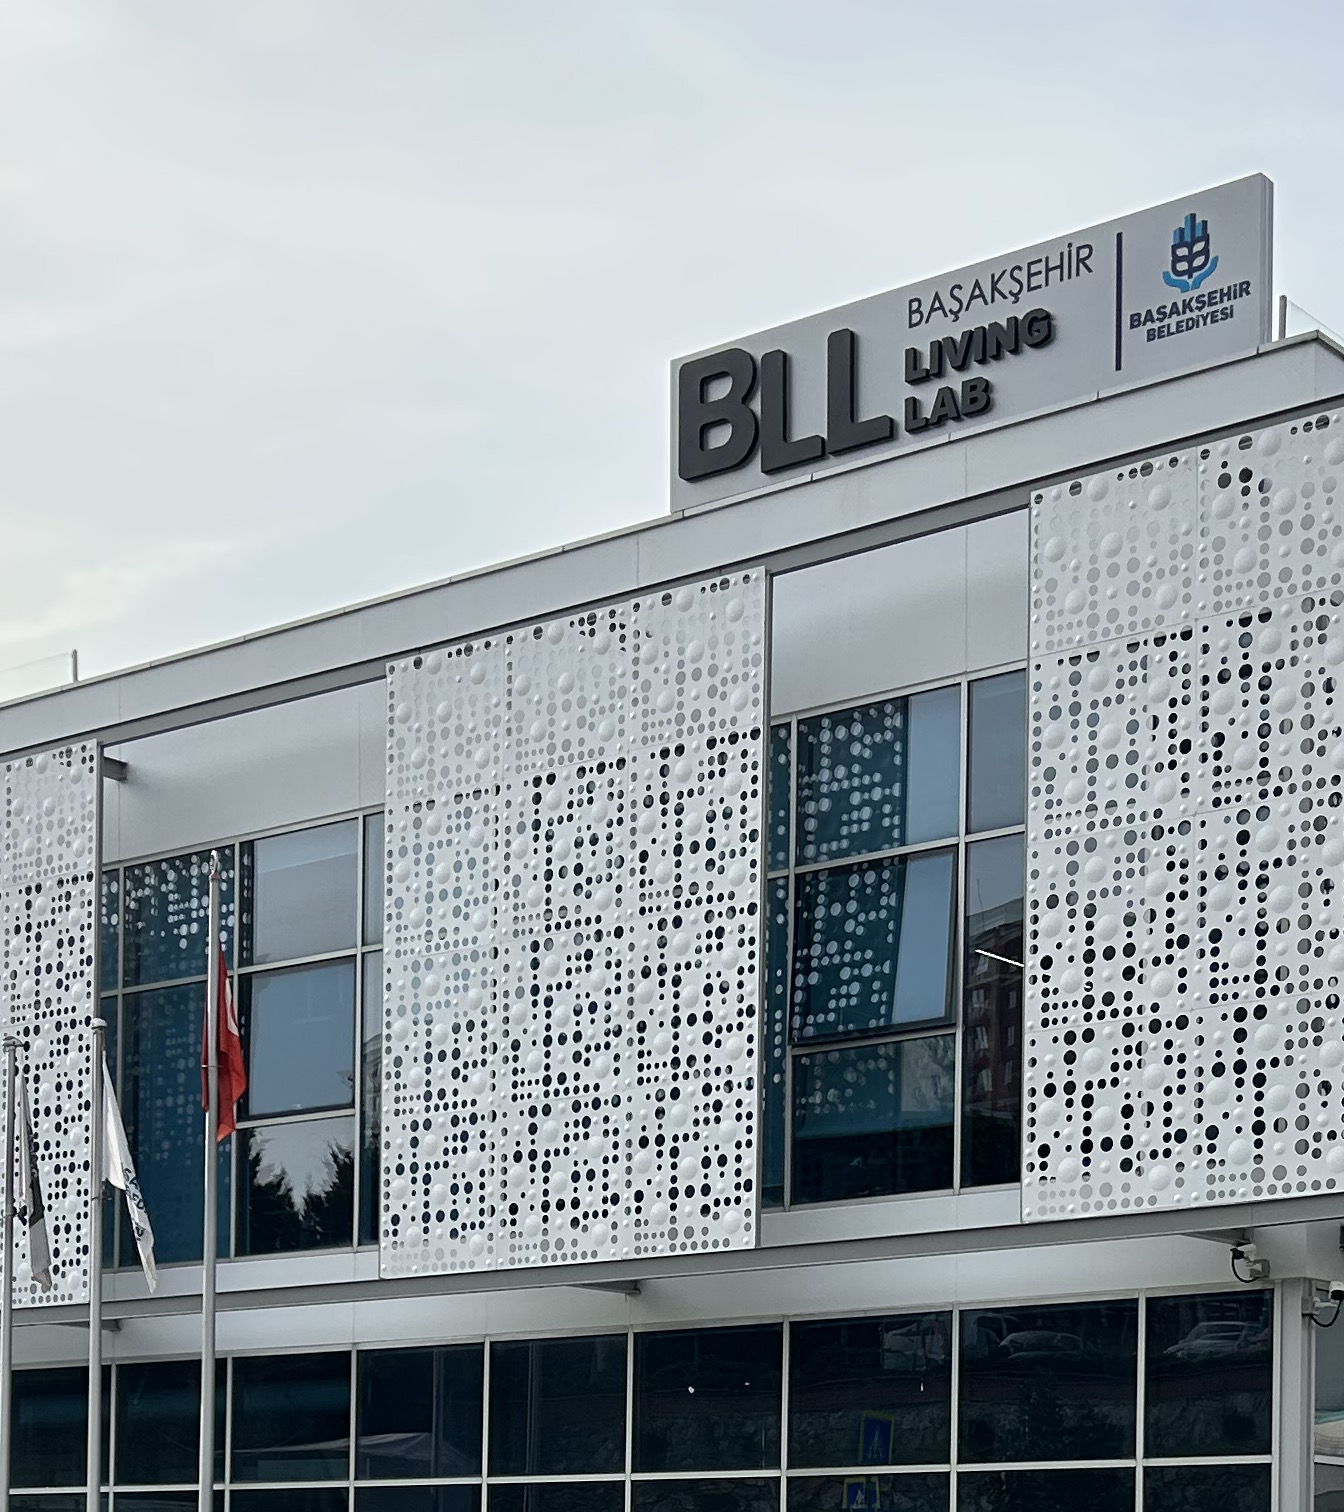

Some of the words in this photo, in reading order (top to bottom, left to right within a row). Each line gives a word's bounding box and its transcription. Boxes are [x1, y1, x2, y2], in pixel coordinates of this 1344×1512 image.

[907, 241, 1094, 330] BAŞAKŞEHİR
[904, 307, 1054, 385] LIVING
[678, 327, 895, 484] BLL
[904, 376, 993, 434] LAB
